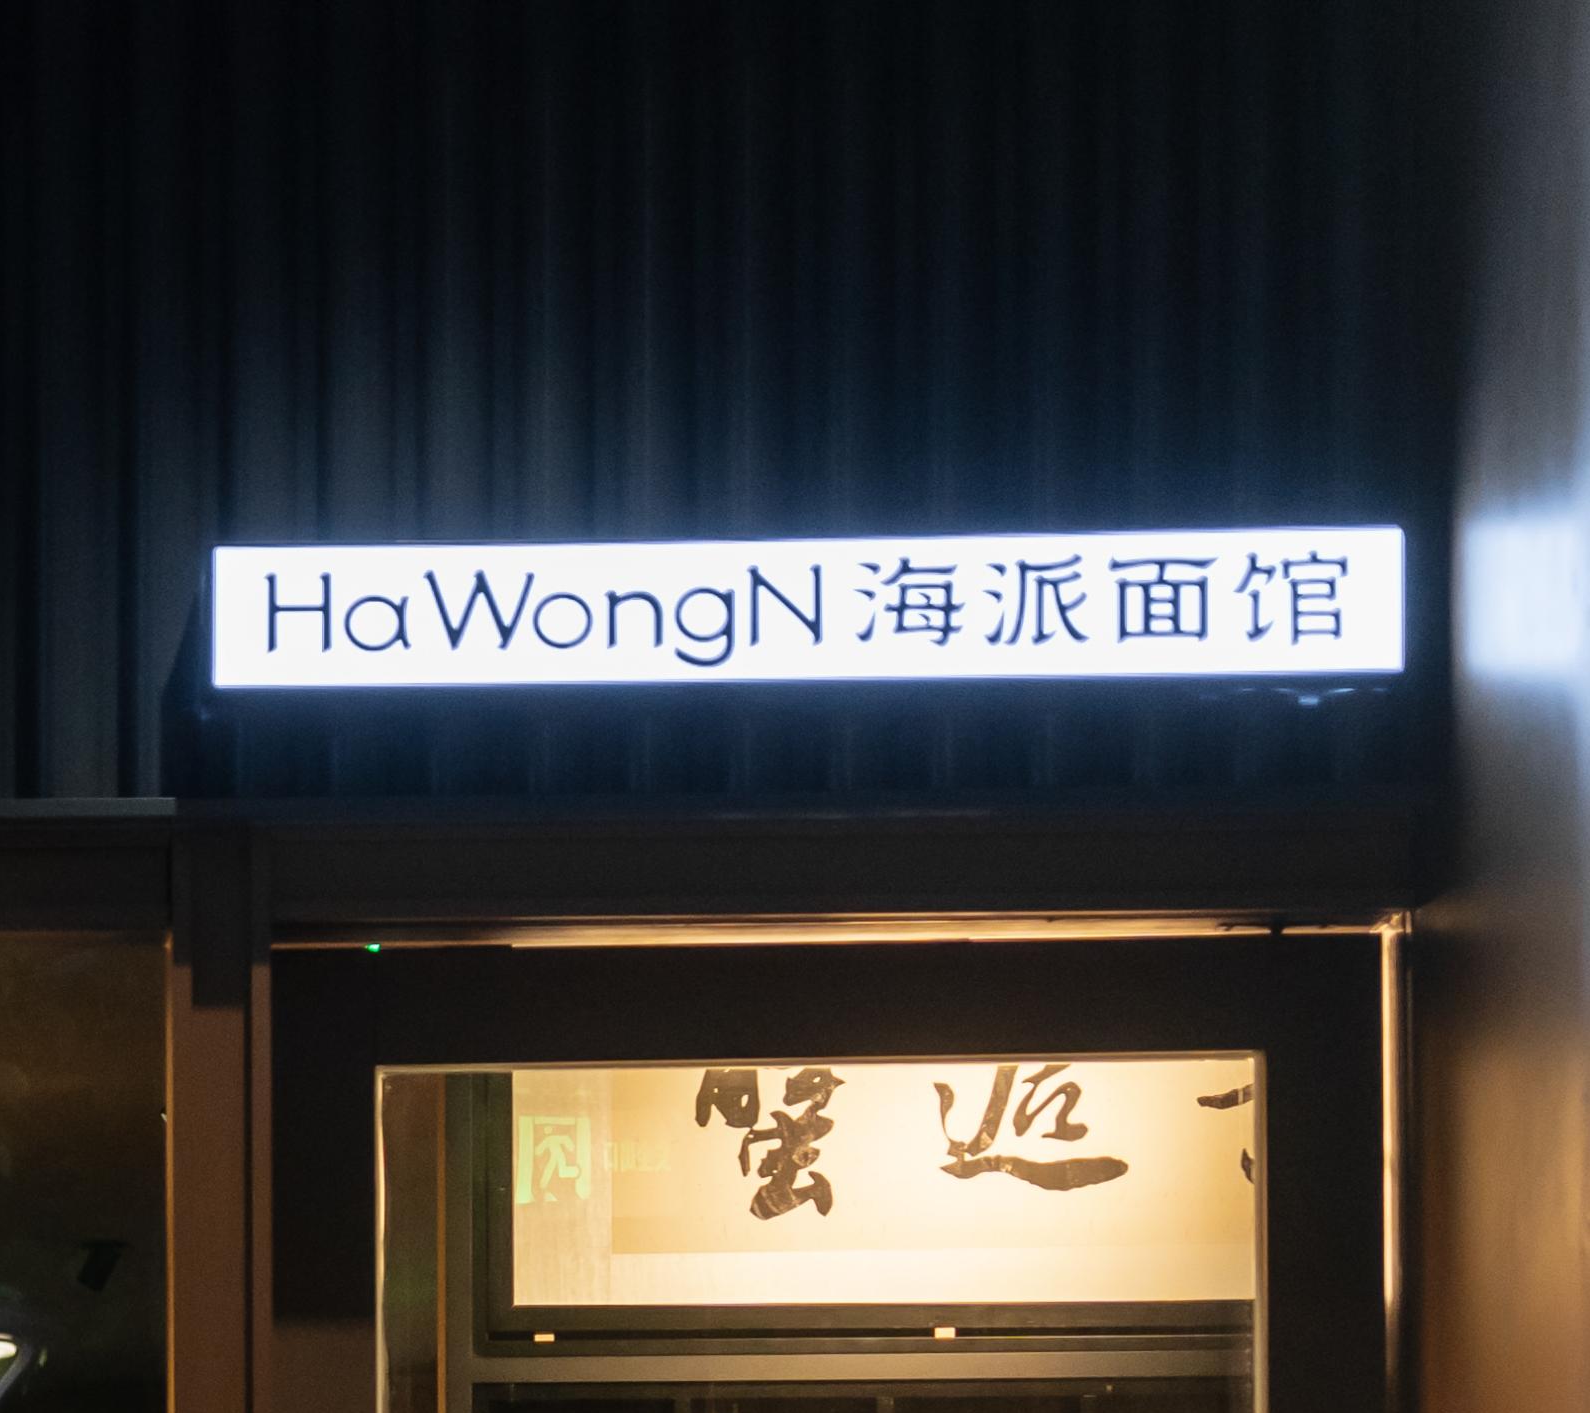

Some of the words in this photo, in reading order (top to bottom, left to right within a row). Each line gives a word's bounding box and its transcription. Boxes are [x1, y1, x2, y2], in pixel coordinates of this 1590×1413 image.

[264, 565, 825, 667] HaWongN
[856, 550, 1350, 647] 海派面馆
